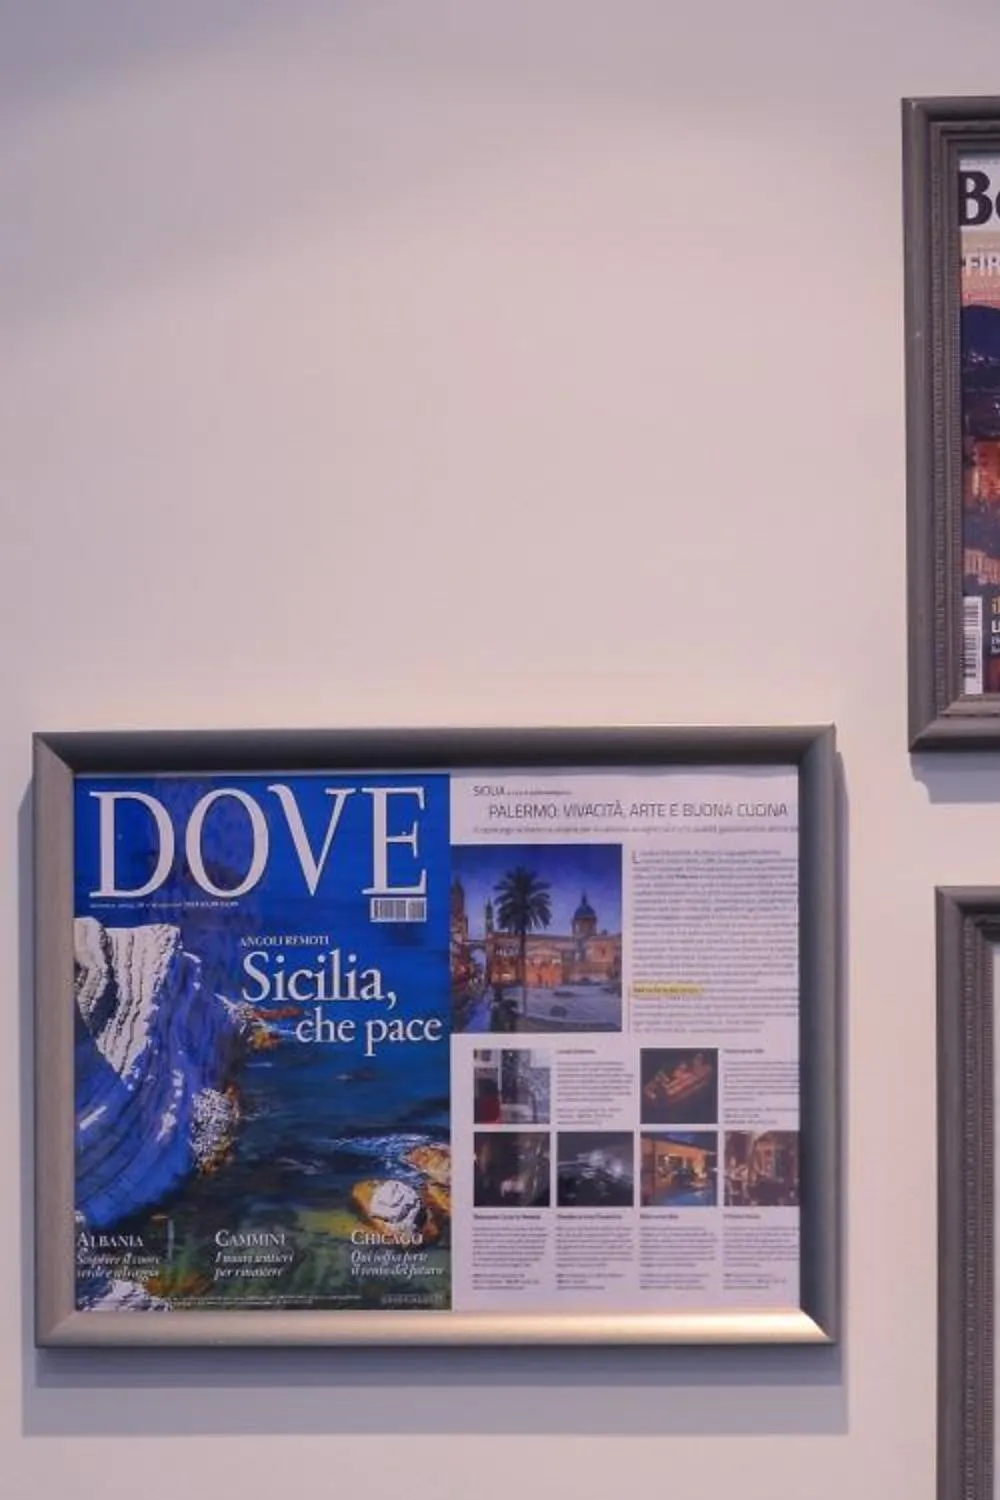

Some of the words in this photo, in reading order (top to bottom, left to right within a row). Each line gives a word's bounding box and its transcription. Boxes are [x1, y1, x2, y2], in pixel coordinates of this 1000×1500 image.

[629, 804, 665, 817] ARTE
[670, 804, 679, 817] E
[683, 804, 733, 817] BUONA
[737, 803, 788, 817] CUCINA
[89, 784, 427, 898] DOVE
[240, 936, 282, 948] ANGOLI
[285, 935, 330, 947] REMOTI
[241, 948, 398, 1010] Sicilia,
[295, 1007, 355, 1042] che
[364, 1017, 443, 1056] pace
[77, 1232, 144, 1247] ALBANIA
[215, 1229, 285, 1247] CAMMINI
[352, 1229, 423, 1246] CHICAGO
